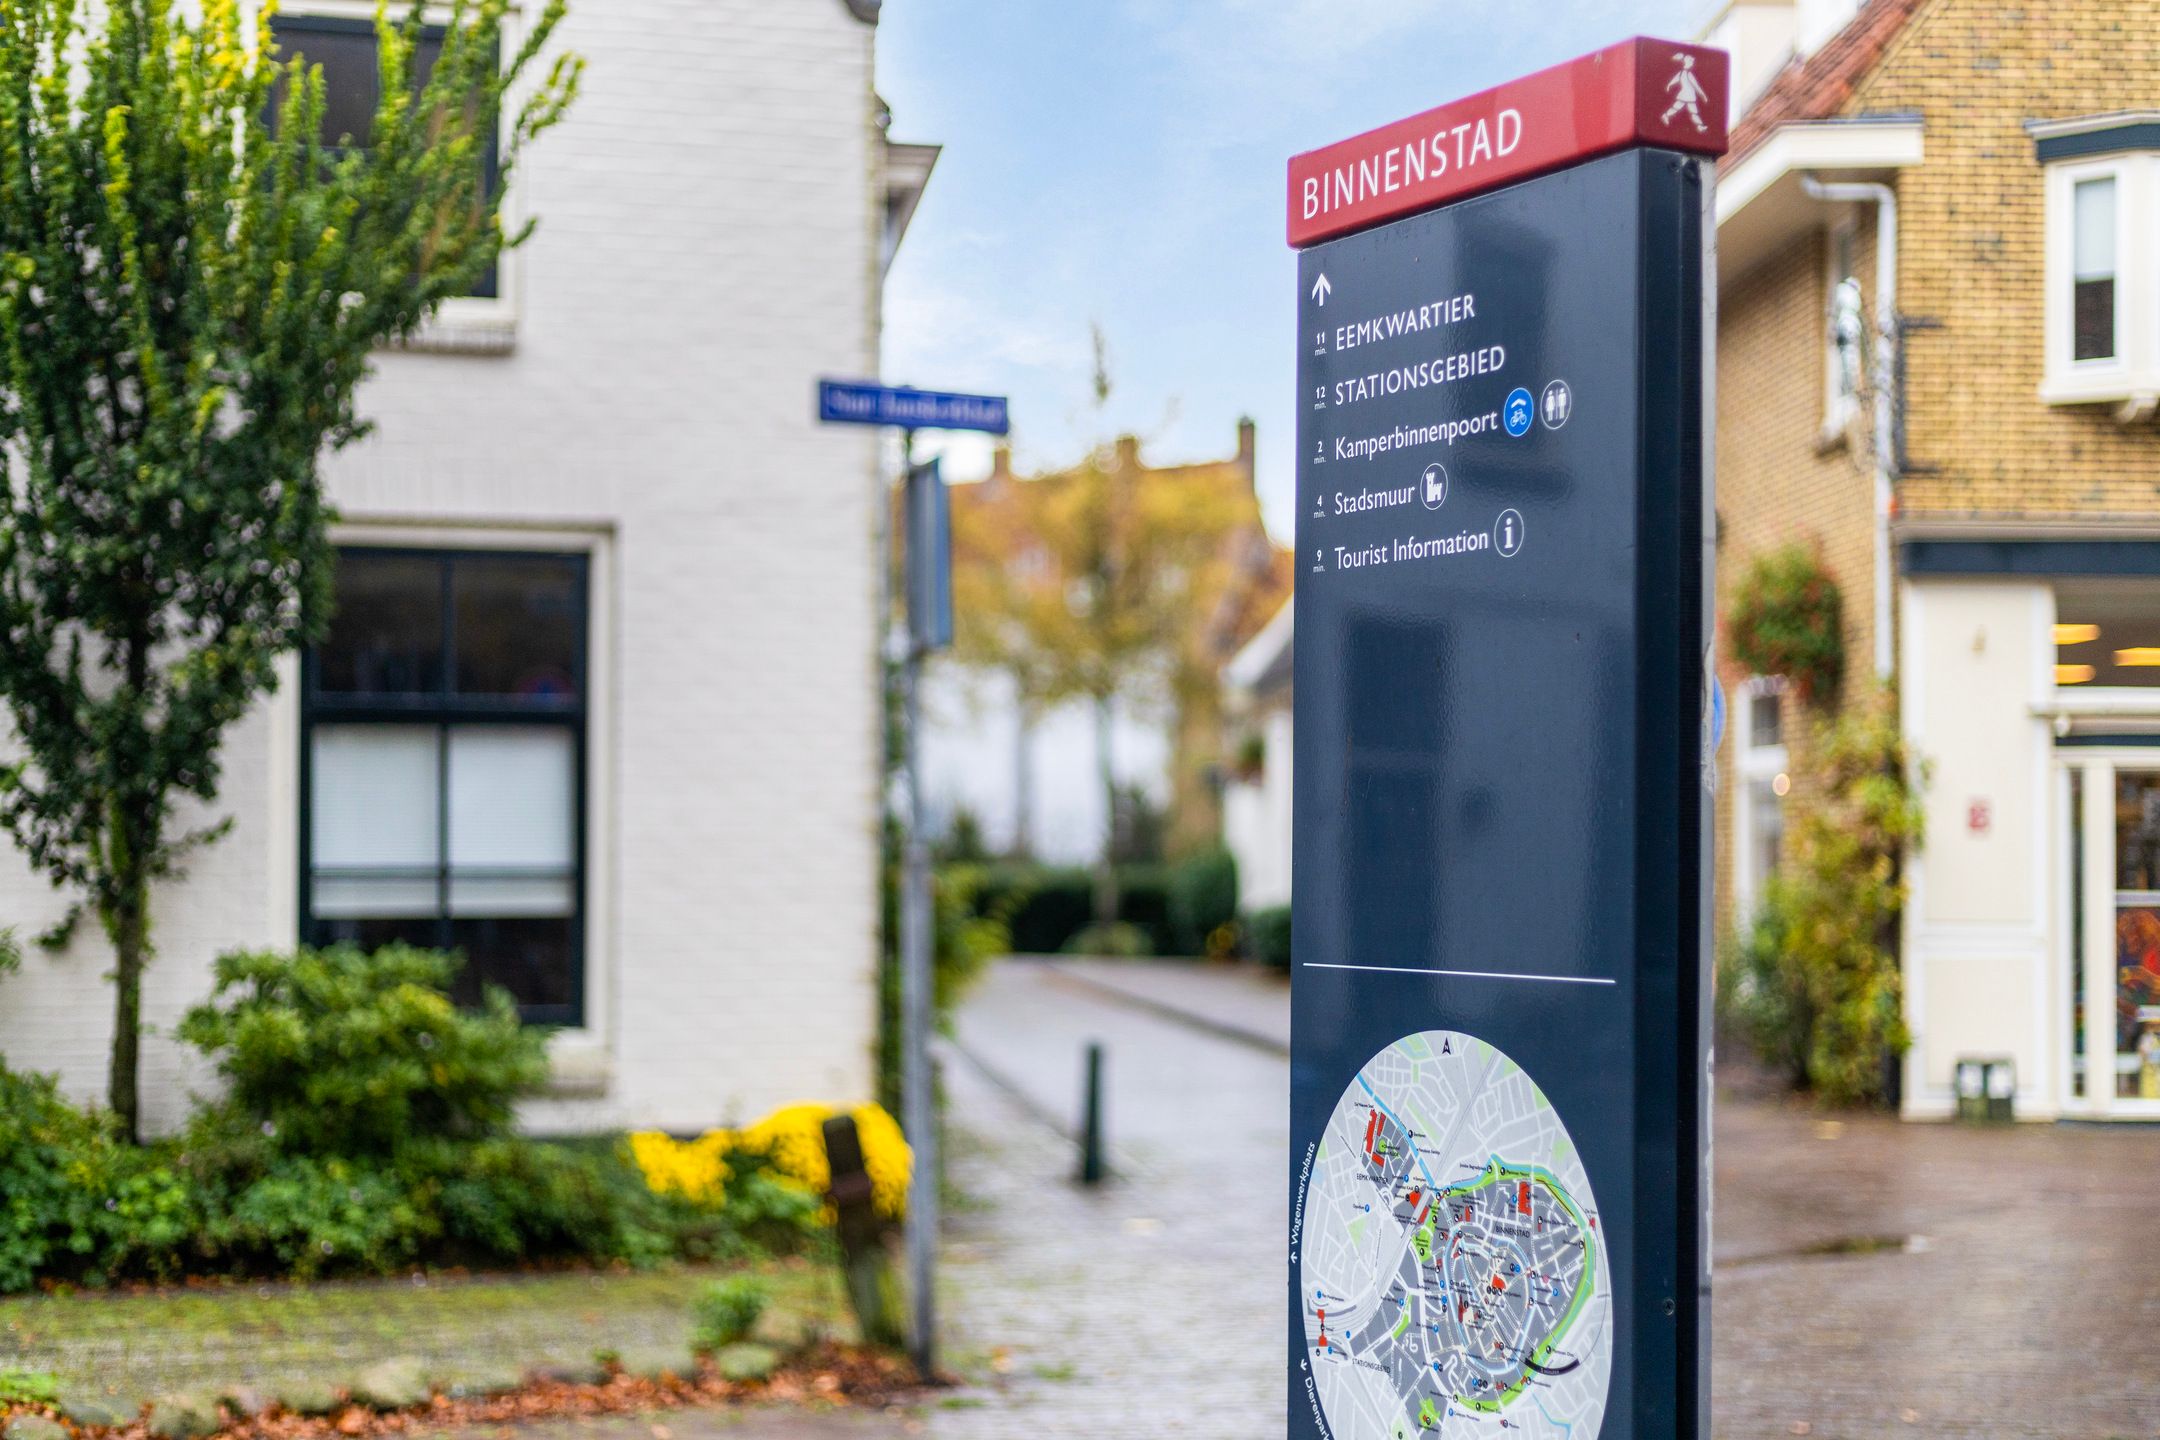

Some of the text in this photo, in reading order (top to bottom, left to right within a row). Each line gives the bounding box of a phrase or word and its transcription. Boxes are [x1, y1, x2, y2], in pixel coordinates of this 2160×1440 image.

[1303, 108, 1521, 219] BINNENSTAD
[1336, 294, 1475, 351] EEMKWARTIER
[1316, 332, 1325, 345] 11
[1335, 345, 1505, 406] STATIONSGEBIED
[1316, 386, 1326, 399] 12
[1317, 440, 1323, 453] 2
[1335, 411, 1498, 461] Kamperbinnenpoort
[1316, 495, 1323, 507] 4
[1335, 487, 1416, 515] Stadsmuur
[1316, 549, 1322, 562] 9
[1334, 529, 1489, 570] Tourist Information
[1291, 1142, 1316, 1245] Wagenwerkplaats
[1495, 1225, 1530, 1238] BINNENSTAD
